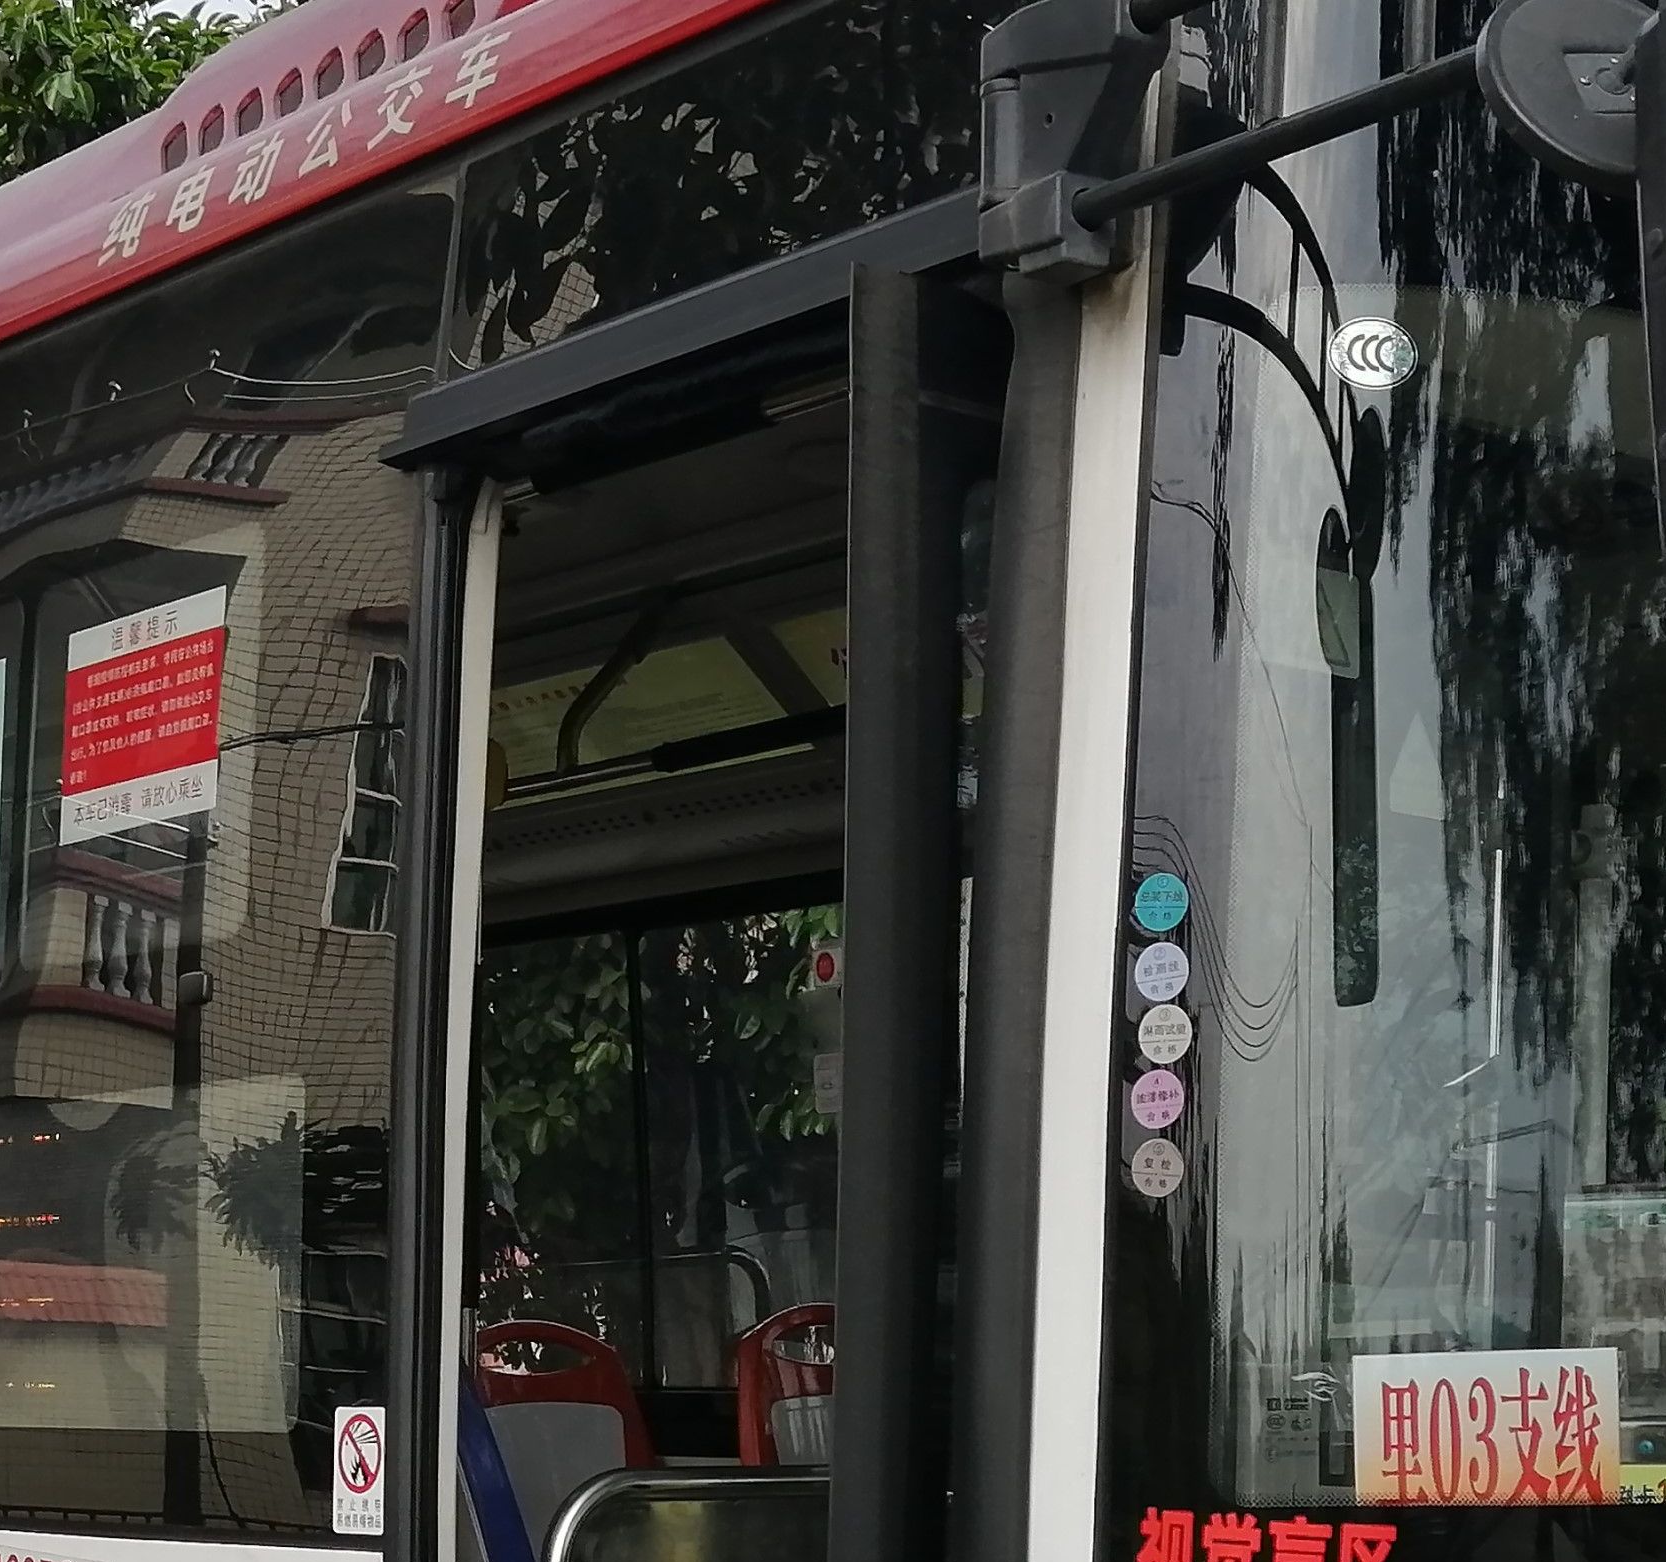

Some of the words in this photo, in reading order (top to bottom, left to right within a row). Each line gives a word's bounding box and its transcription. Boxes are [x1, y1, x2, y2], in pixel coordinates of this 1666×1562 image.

[97, 30, 512, 267] 纯电动公交车
[111, 609, 179, 652] 温馨提示
[141, 775, 204, 808] 请放心乘坐
[1380, 1365, 1603, 1506] 里03支线
